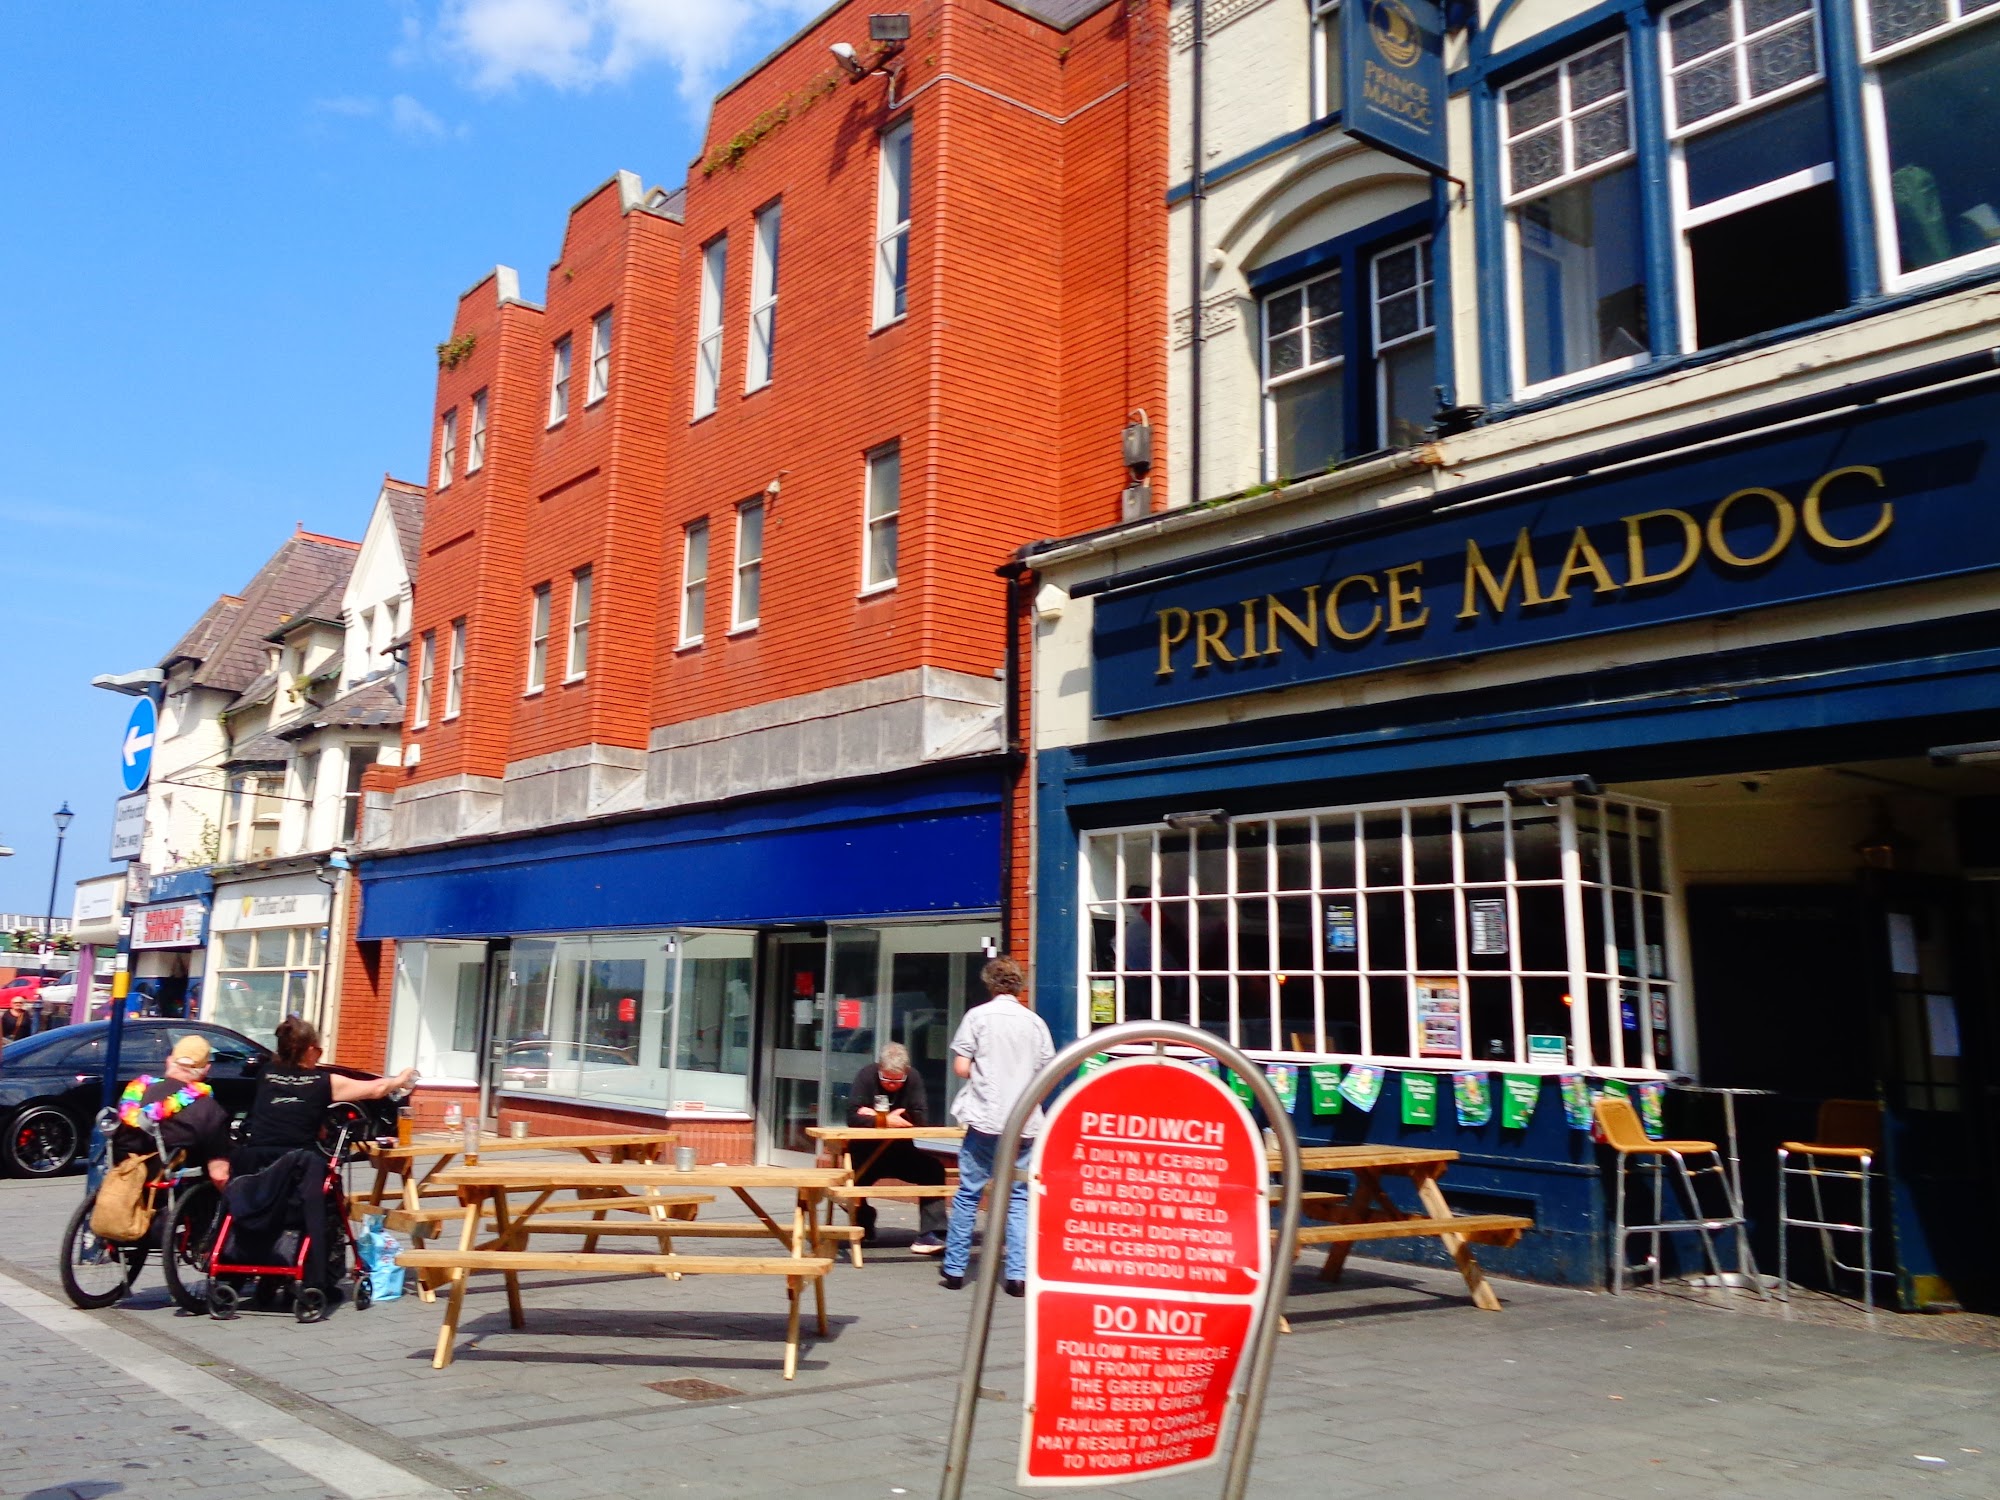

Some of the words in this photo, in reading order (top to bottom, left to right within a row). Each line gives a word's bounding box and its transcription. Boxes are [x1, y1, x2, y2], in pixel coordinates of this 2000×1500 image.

[1364, 60, 1429, 104] PRINCE
[1363, 80, 1432, 124] MADOC
[1155, 560, 1431, 676] PRINCE
[1457, 465, 1894, 618] MADOC
[1080, 1112, 1225, 1144] PEIDIWCH
[1089, 1148, 1141, 1165] DILYN
[1144, 1152, 1157, 1166] Y
[1158, 1153, 1229, 1172] CERBYD
[1126, 1168, 1182, 1185] BLAEN
[1185, 1172, 1220, 1188] ONI
[1082, 1181, 1112, 1197] BAI
[1116, 1184, 1154, 1200] BOD
[1157, 1187, 1217, 1205] GOLAU
[1070, 1198, 1146, 1217] GWYRDD
[1179, 1206, 1228, 1223] WELD
[1064, 1218, 1144, 1238] GALLECH
[1147, 1225, 1233, 1245] DDIFRODI
[1063, 1237, 1106, 1254] EICH
[1110, 1240, 1181, 1260] CERBYD
[1184, 1246, 1236, 1264] DRWY
[1071, 1257, 1185, 1279] ANWYBYDDU
[1189, 1266, 1227, 1283] HYN
[1093, 1304, 1138, 1331] DO
[1146, 1307, 1207, 1335] NOT
[1056, 1339, 1126, 1359] FOLLOW
[1129, 1345, 1162, 1361] THE
[1166, 1346, 1231, 1361] VEHICLE
[1070, 1359, 1091, 1375] IN
[1094, 1361, 1152, 1377] FRONT
[1154, 1362, 1215, 1378] UNLESS
[1070, 1377, 1103, 1394] THE
[1106, 1378, 1164, 1394] GREEN
[1167, 1378, 1211, 1394] LIGHT
[1070, 1396, 1107, 1411] HAS
[1110, 1397, 1156, 1412] BEEN
[1157, 1394, 1204, 1411] GIVEN
[1056, 1417, 1126, 1433] FAILURE
[1128, 1418, 1150, 1432] TO
[1151, 1410, 1209, 1430] COMPLY
[1036, 1435, 1074, 1450] MAY
[1076, 1436, 1138, 1450] RESULT
[1140, 1435, 1159, 1449] IN
[1160, 1422, 1217, 1446] DAMAGE
[1063, 1454, 1085, 1469] TO
[1088, 1453, 1132, 1468] YOUR
[1135, 1443, 1193, 1465] VEHICLE
